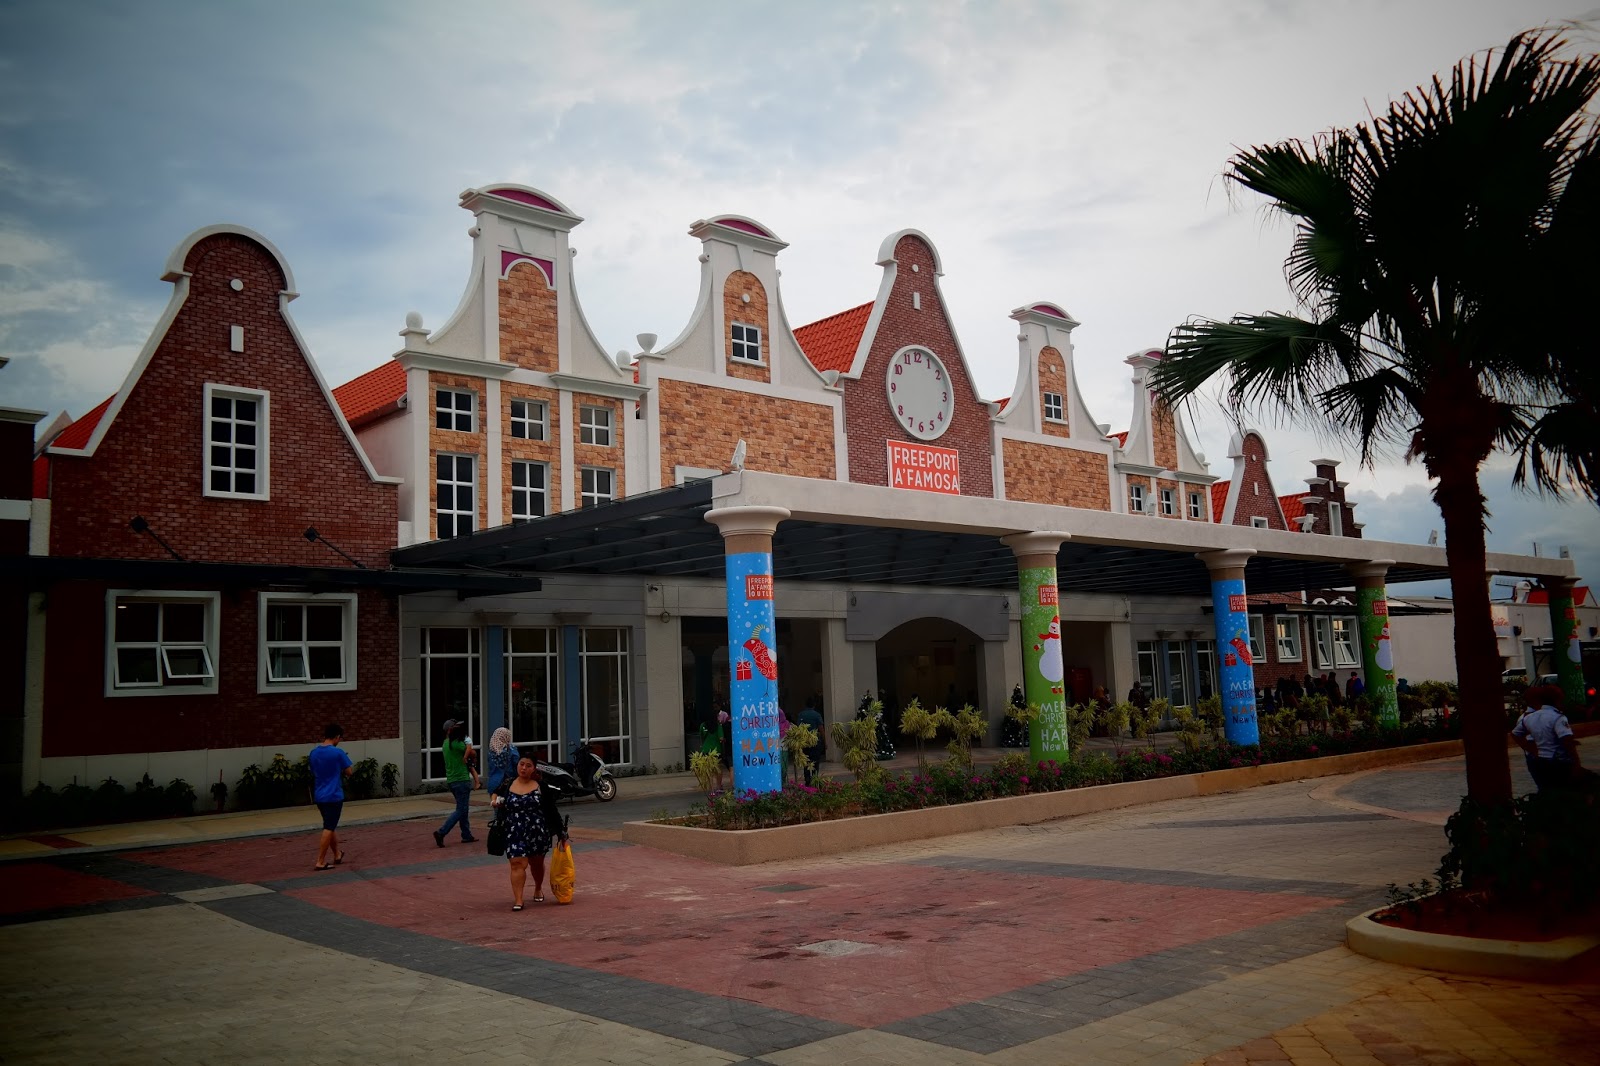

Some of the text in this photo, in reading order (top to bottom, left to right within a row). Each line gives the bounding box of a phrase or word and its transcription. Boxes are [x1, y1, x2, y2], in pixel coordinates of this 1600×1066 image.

[904, 354, 911, 365] 11
[914, 352, 922, 364] 12
[926, 358, 931, 369] 1
[894, 364, 903, 375] 10
[936, 370, 941, 380] 2
[890, 382, 896, 393] 9
[942, 392, 948, 402] 3
[898, 406, 904, 416] 8
[938, 412, 943, 422] 4
[908, 418, 914, 428] 7
[918, 422, 924, 433] 6
[930, 420, 935, 431] 5
[894, 446, 957, 471] FREEPORT
[894, 467, 959, 491] A'FAMOSA
[1042, 741, 1061, 752] New
[742, 754, 766, 767] New
